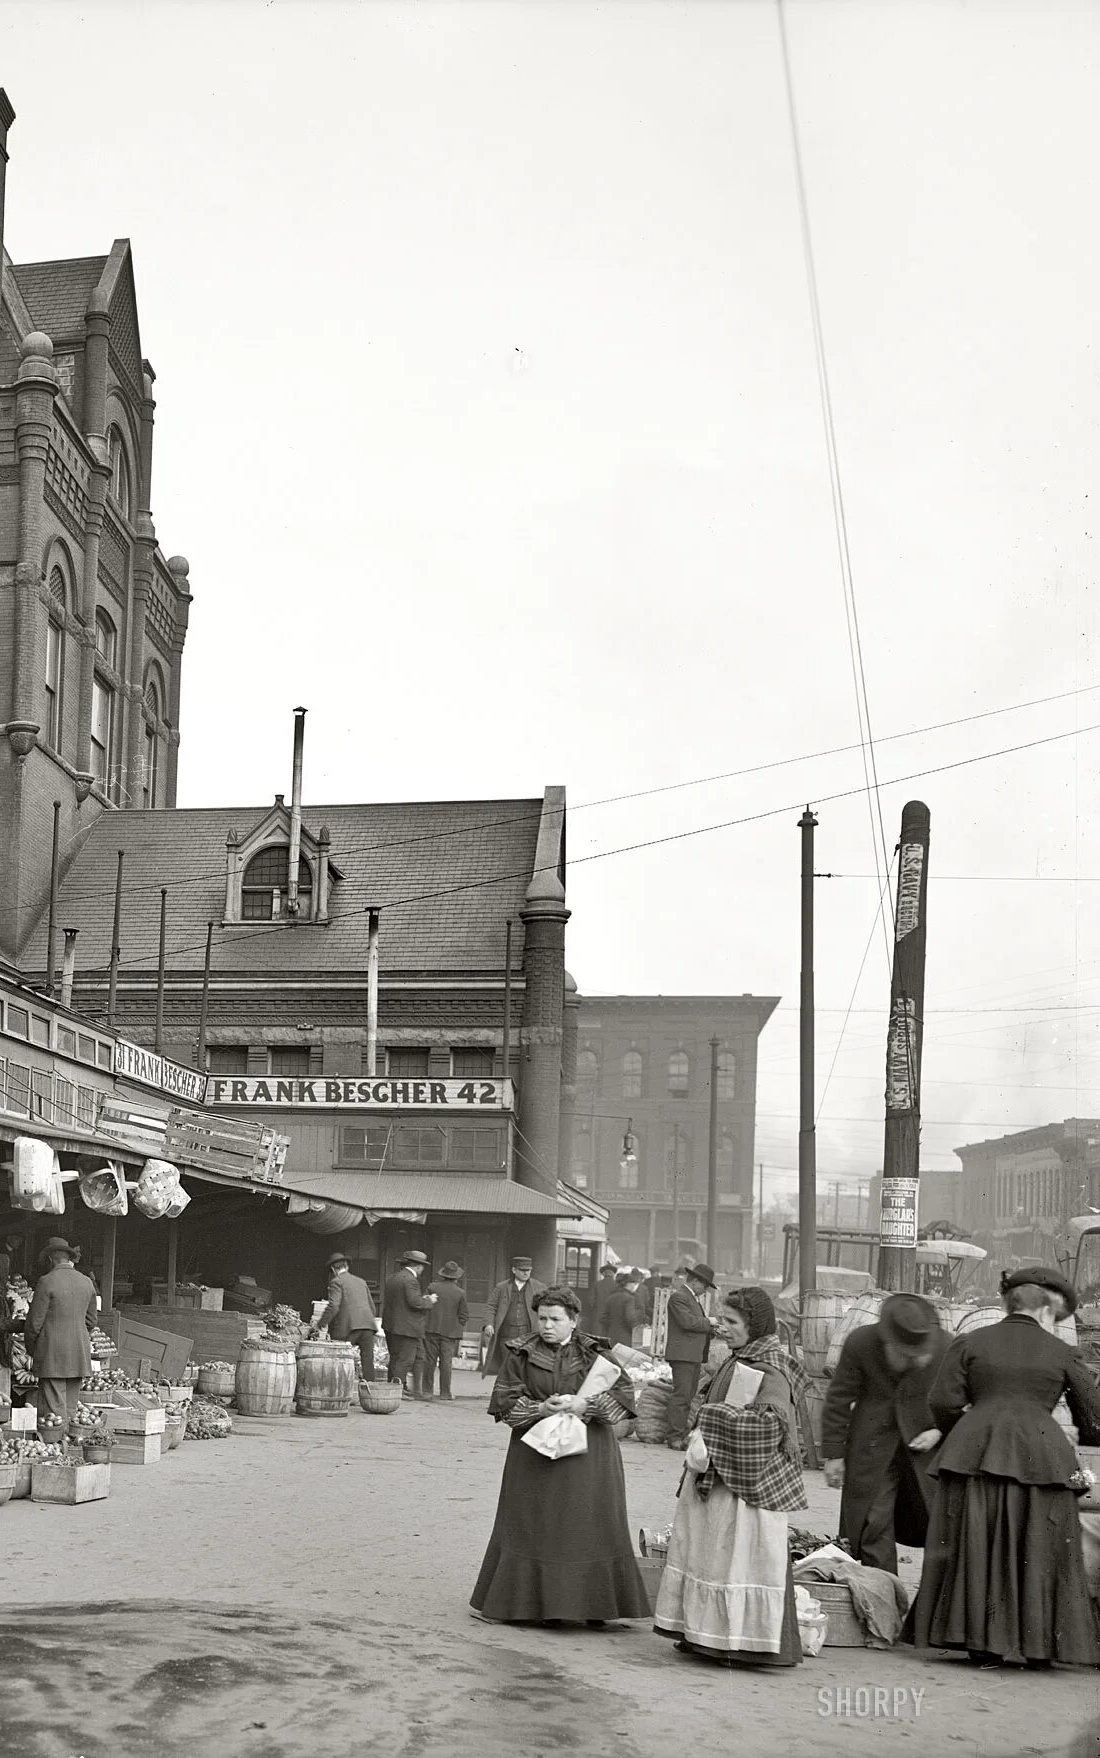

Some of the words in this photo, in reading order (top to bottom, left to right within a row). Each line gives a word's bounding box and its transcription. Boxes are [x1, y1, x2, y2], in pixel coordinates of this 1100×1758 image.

[901, 868, 919, 898] NAVY
[128, 1046, 160, 1085] FRANK
[164, 1061, 196, 1099] BESCHER
[892, 1052, 909, 1083] NAVY
[213, 1080, 318, 1102] FRANK
[325, 1082, 448, 1103] BESCHER
[457, 1082, 497, 1103] 42
[891, 1197, 906, 1207] THE
